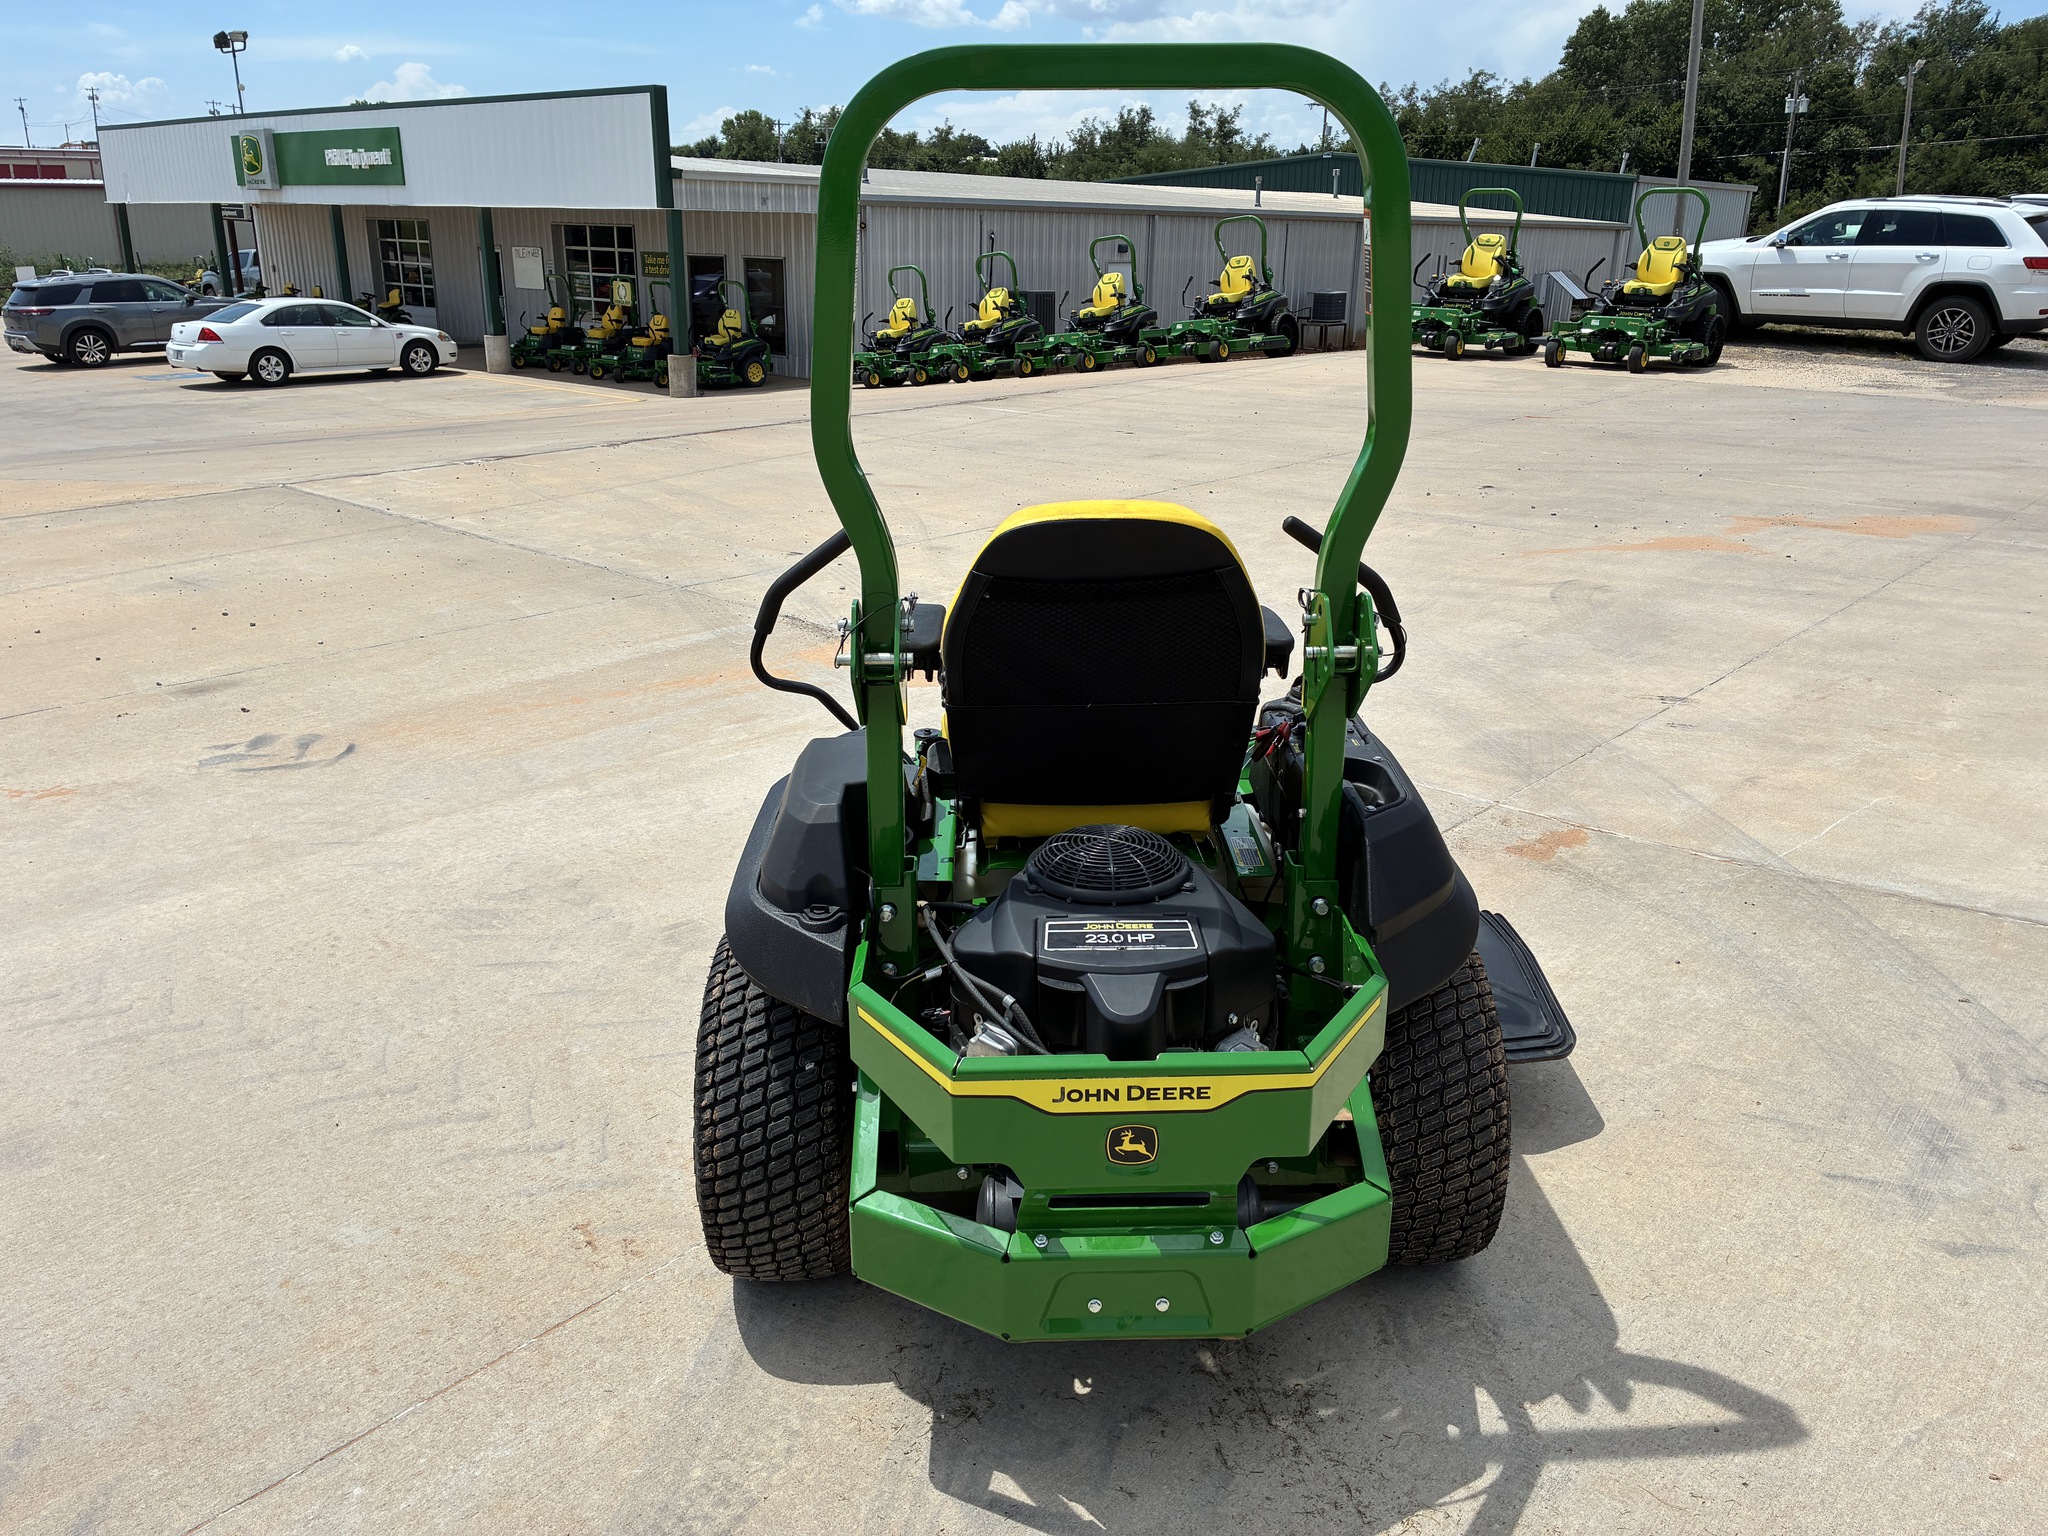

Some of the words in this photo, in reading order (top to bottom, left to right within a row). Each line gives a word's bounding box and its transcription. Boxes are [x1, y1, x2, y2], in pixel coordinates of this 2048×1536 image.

[644, 254, 656, 264] Take
[657, 257, 665, 265] me
[645, 266, 649, 274] a
[649, 265, 659, 274] test
[660, 265, 670, 275] driv
[1085, 933, 1124, 944] 23.0
[1127, 933, 1155, 943] HP
[1052, 1087, 1119, 1103] JOHN
[1127, 1085, 1211, 1101] DEERE
